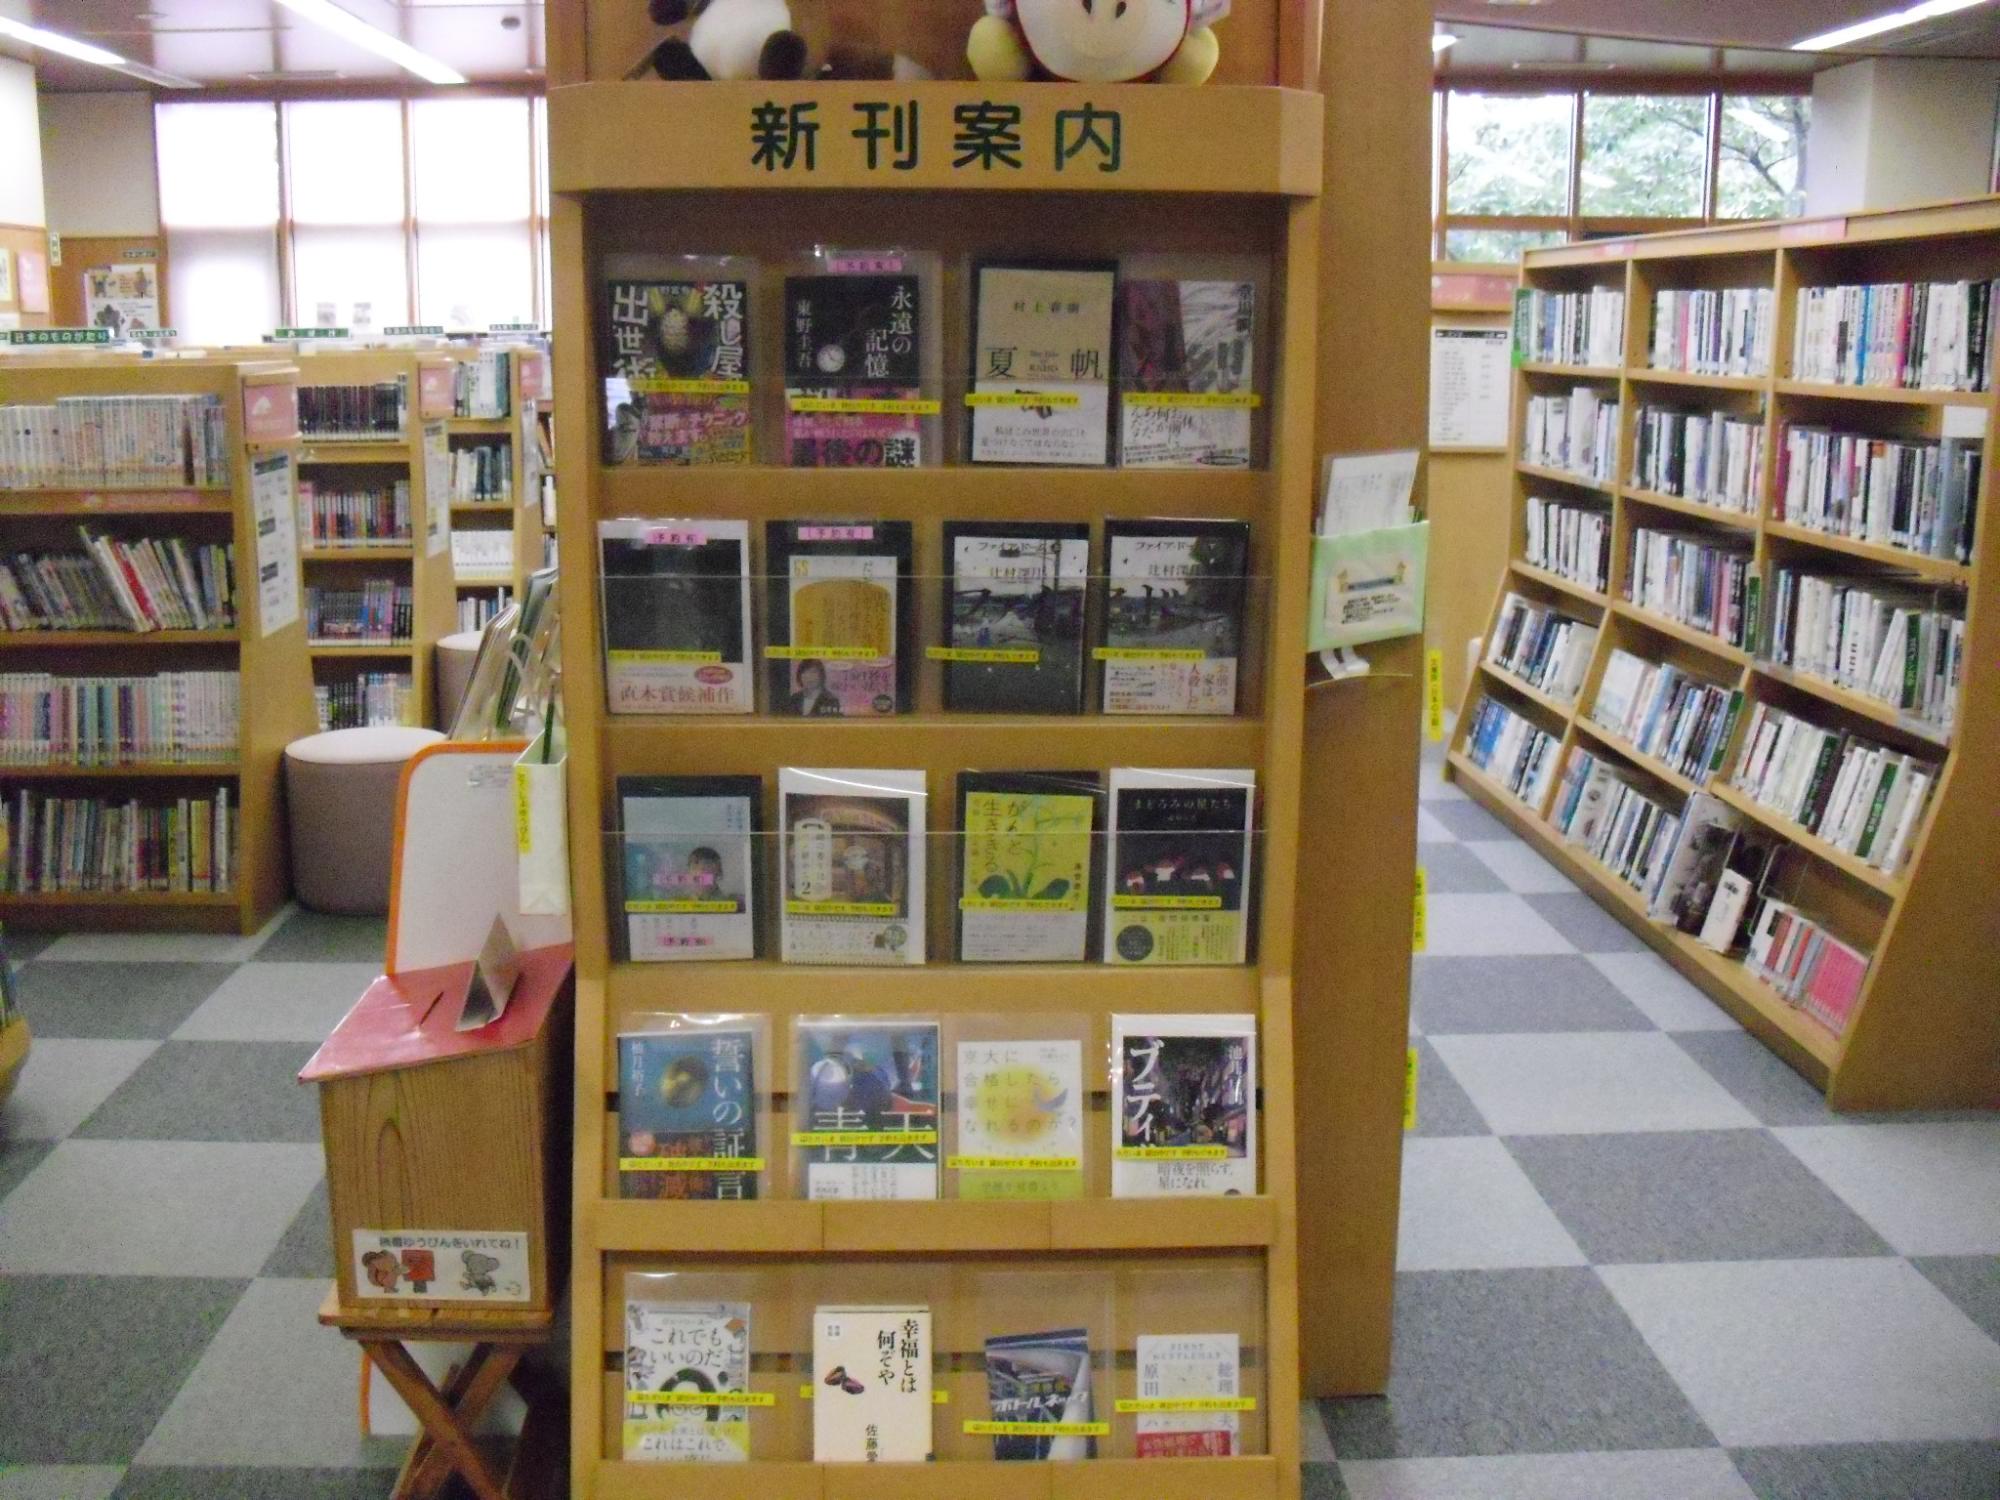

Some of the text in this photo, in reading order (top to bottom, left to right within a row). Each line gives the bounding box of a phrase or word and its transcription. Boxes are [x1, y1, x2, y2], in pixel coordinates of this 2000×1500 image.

[750, 99, 1121, 171] 新刊案内
[702, 283, 744, 380] 殺し屋
[890, 285, 913, 354] 永遠の
[711, 1039, 746, 1199] 誓いの証言
[650, 1327, 722, 1347] これでも
[650, 1349, 722, 1368] いいのだ
[877, 1330, 897, 1386] 何ぞや
[901, 1318, 920, 1394] 幸福とは
